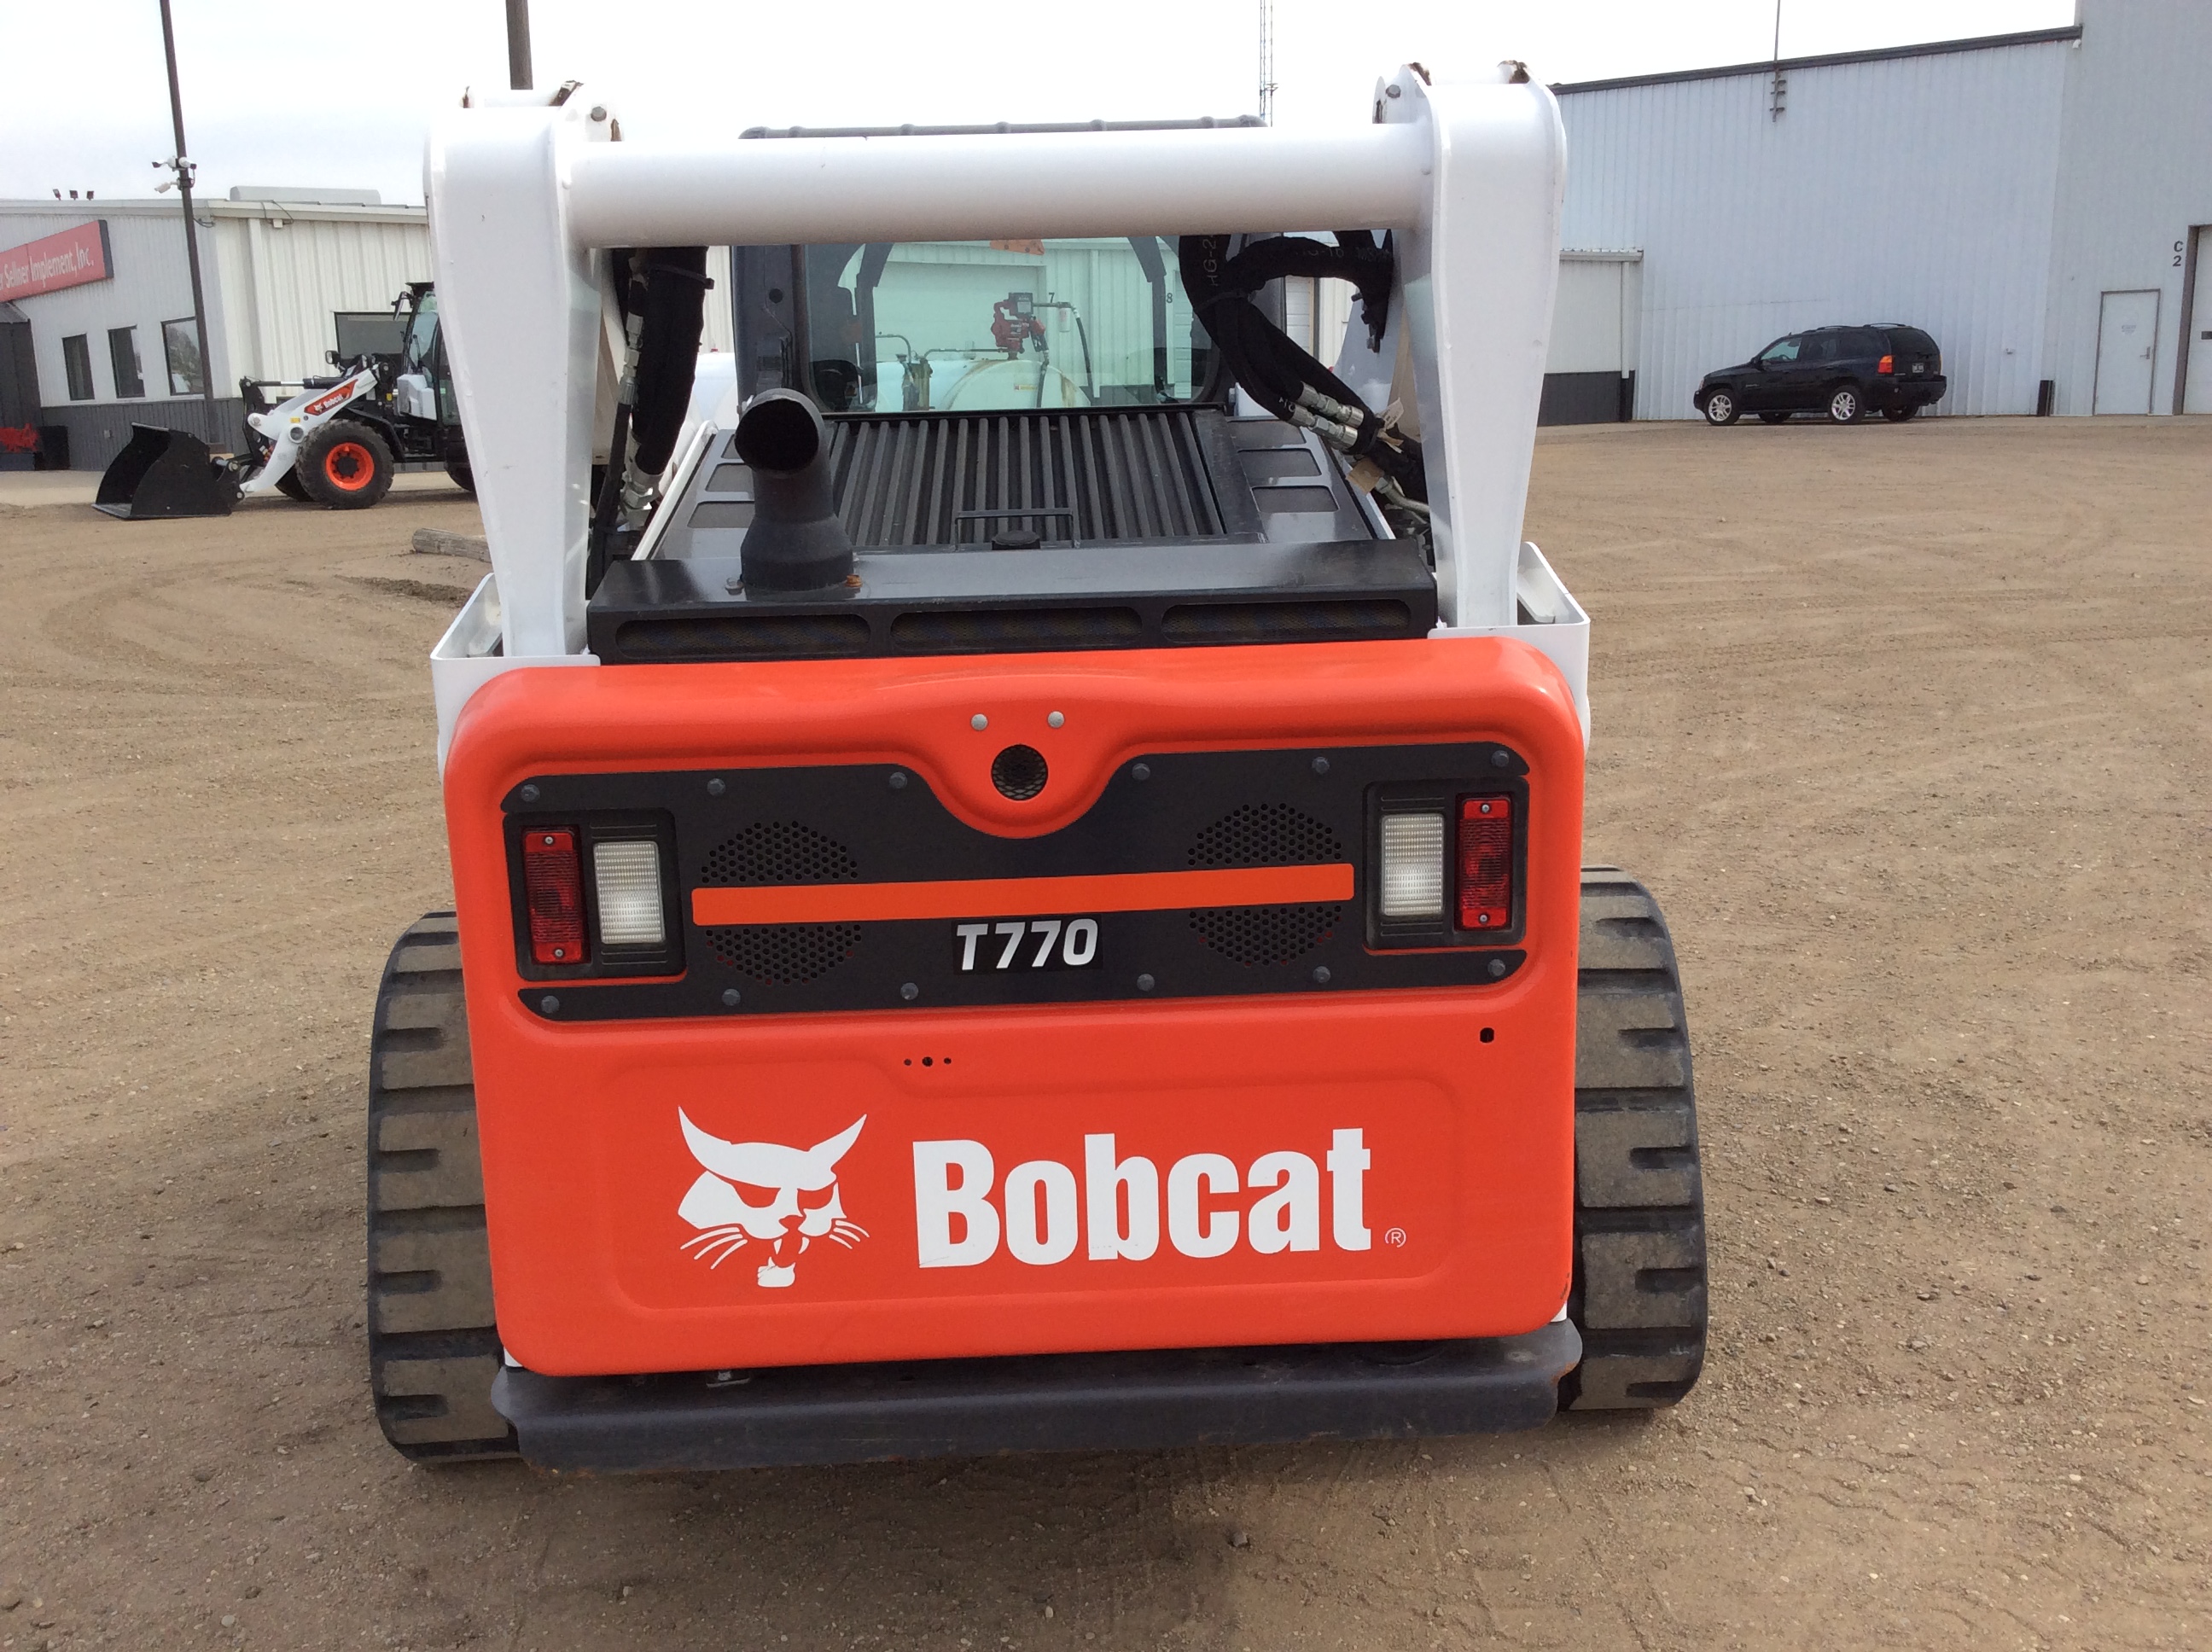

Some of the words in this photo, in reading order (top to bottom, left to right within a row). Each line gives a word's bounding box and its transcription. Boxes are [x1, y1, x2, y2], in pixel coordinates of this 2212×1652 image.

[29, 250, 78, 288] Implement,
[75, 241, 95, 270] Inc.
[1048, 292, 1055, 304] 7
[1166, 292, 1173, 304] 8
[323, 393, 344, 409] Bobcat
[957, 918, 1098, 970] T770
[912, 1127, 1371, 1269] Bobcat
